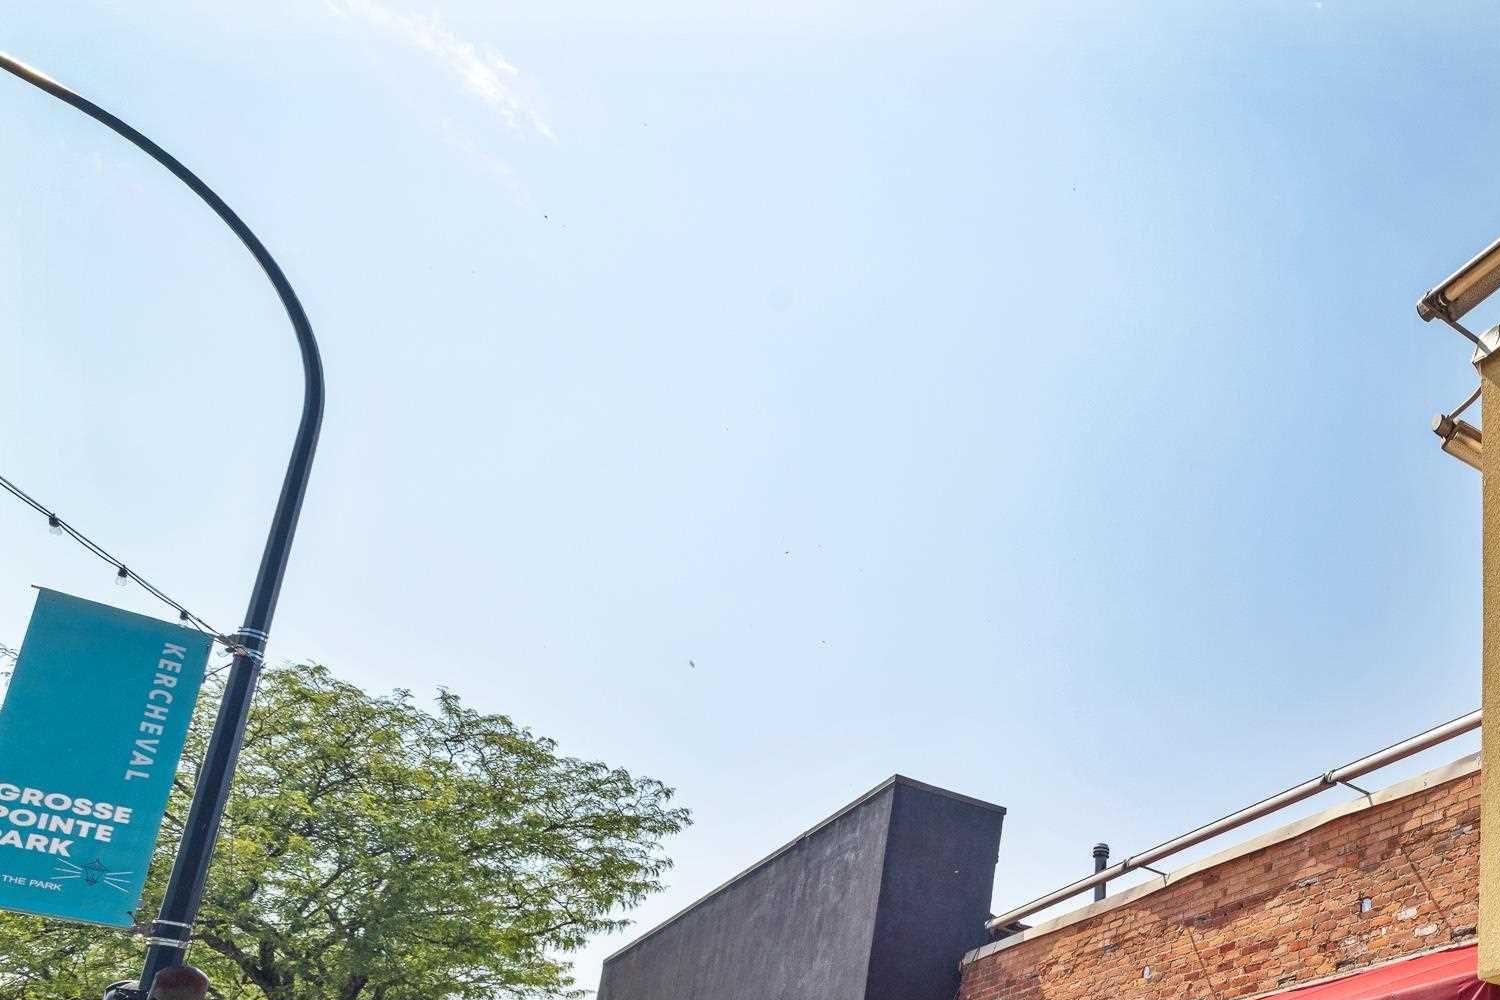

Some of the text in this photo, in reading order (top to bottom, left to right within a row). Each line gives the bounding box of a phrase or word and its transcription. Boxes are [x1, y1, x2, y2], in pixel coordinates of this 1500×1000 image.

[124, 642, 188, 780] KERCHEVAL
[0, 783, 133, 824] GROSSE
[0, 830, 74, 857] ARK
[2, 874, 62, 891] THE PARK
